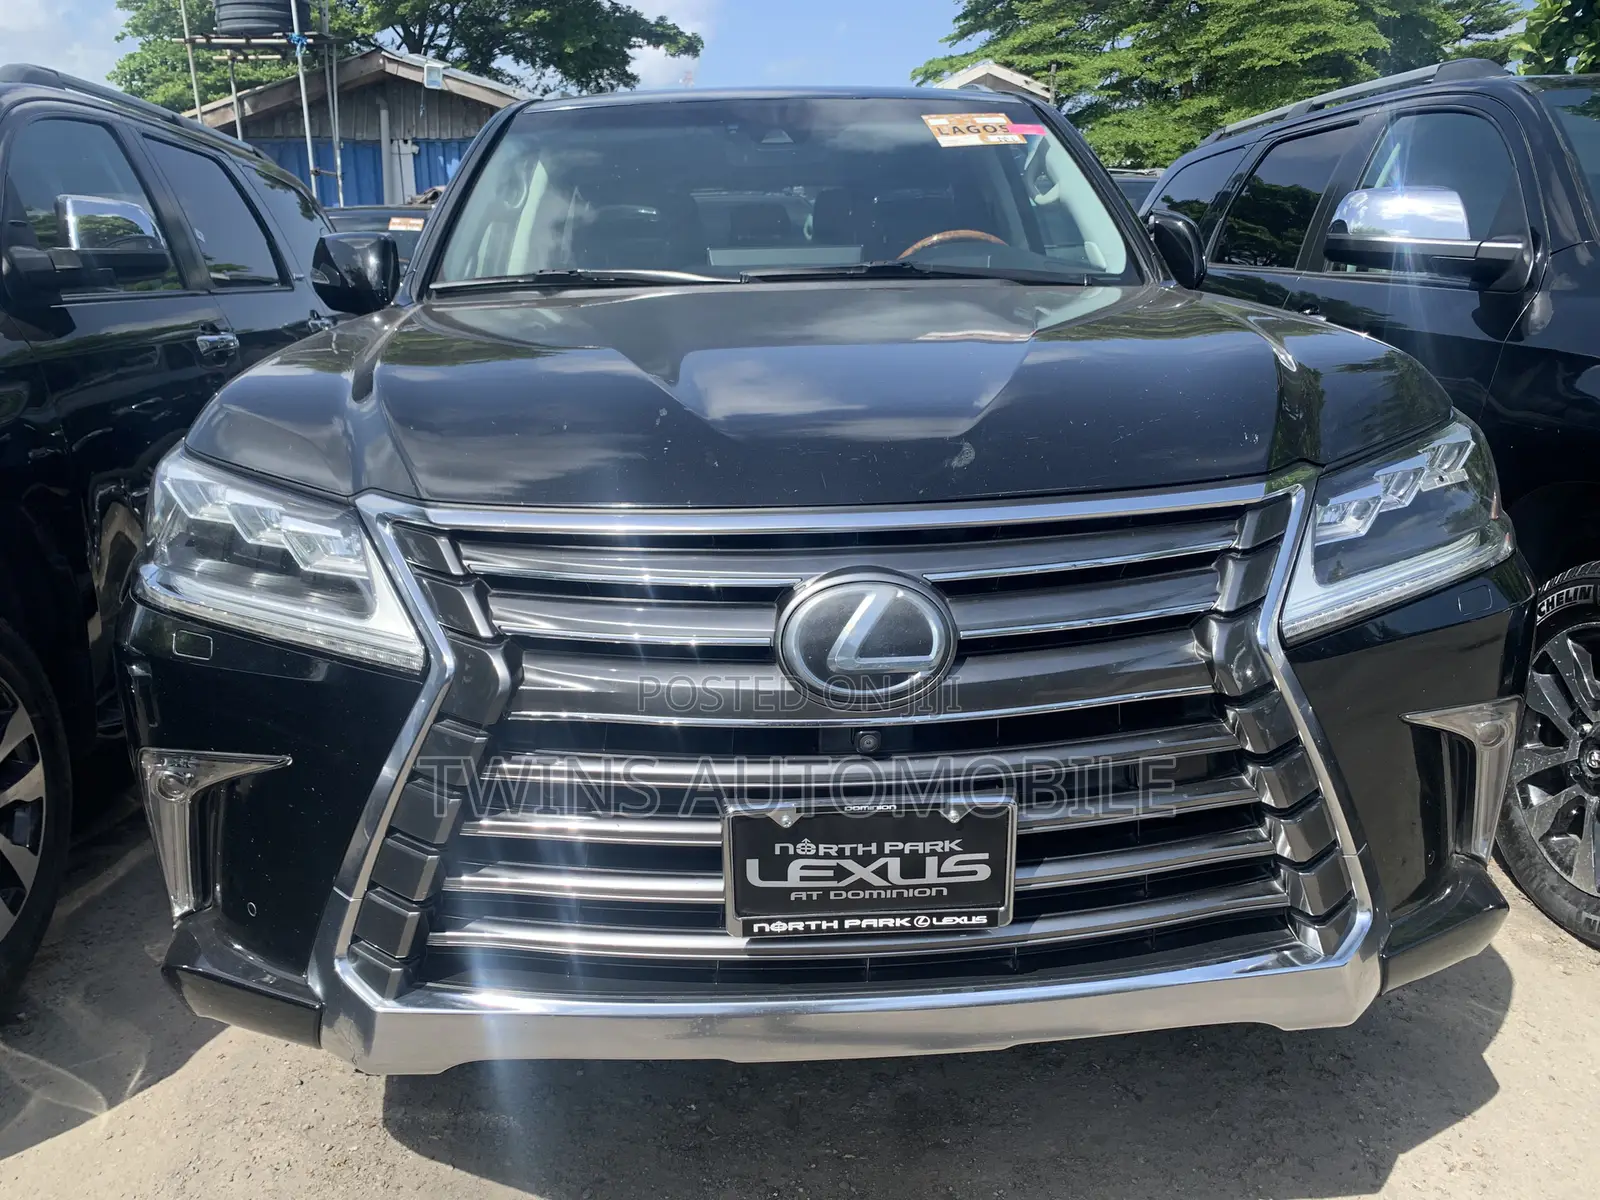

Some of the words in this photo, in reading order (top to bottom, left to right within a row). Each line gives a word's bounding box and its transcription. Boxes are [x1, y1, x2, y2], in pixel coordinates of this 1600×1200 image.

[936, 124, 1010, 136] LAGOS
[774, 838, 877, 857] NORTH
[884, 838, 964, 854] PARK
[746, 852, 992, 888] LEXUS
[790, 890, 823, 901] AT
[829, 887, 948, 900] DOMINION
[753, 920, 839, 933] NORTH
[844, 917, 911, 929] PARK
[932, 915, 988, 925] LEXUS
